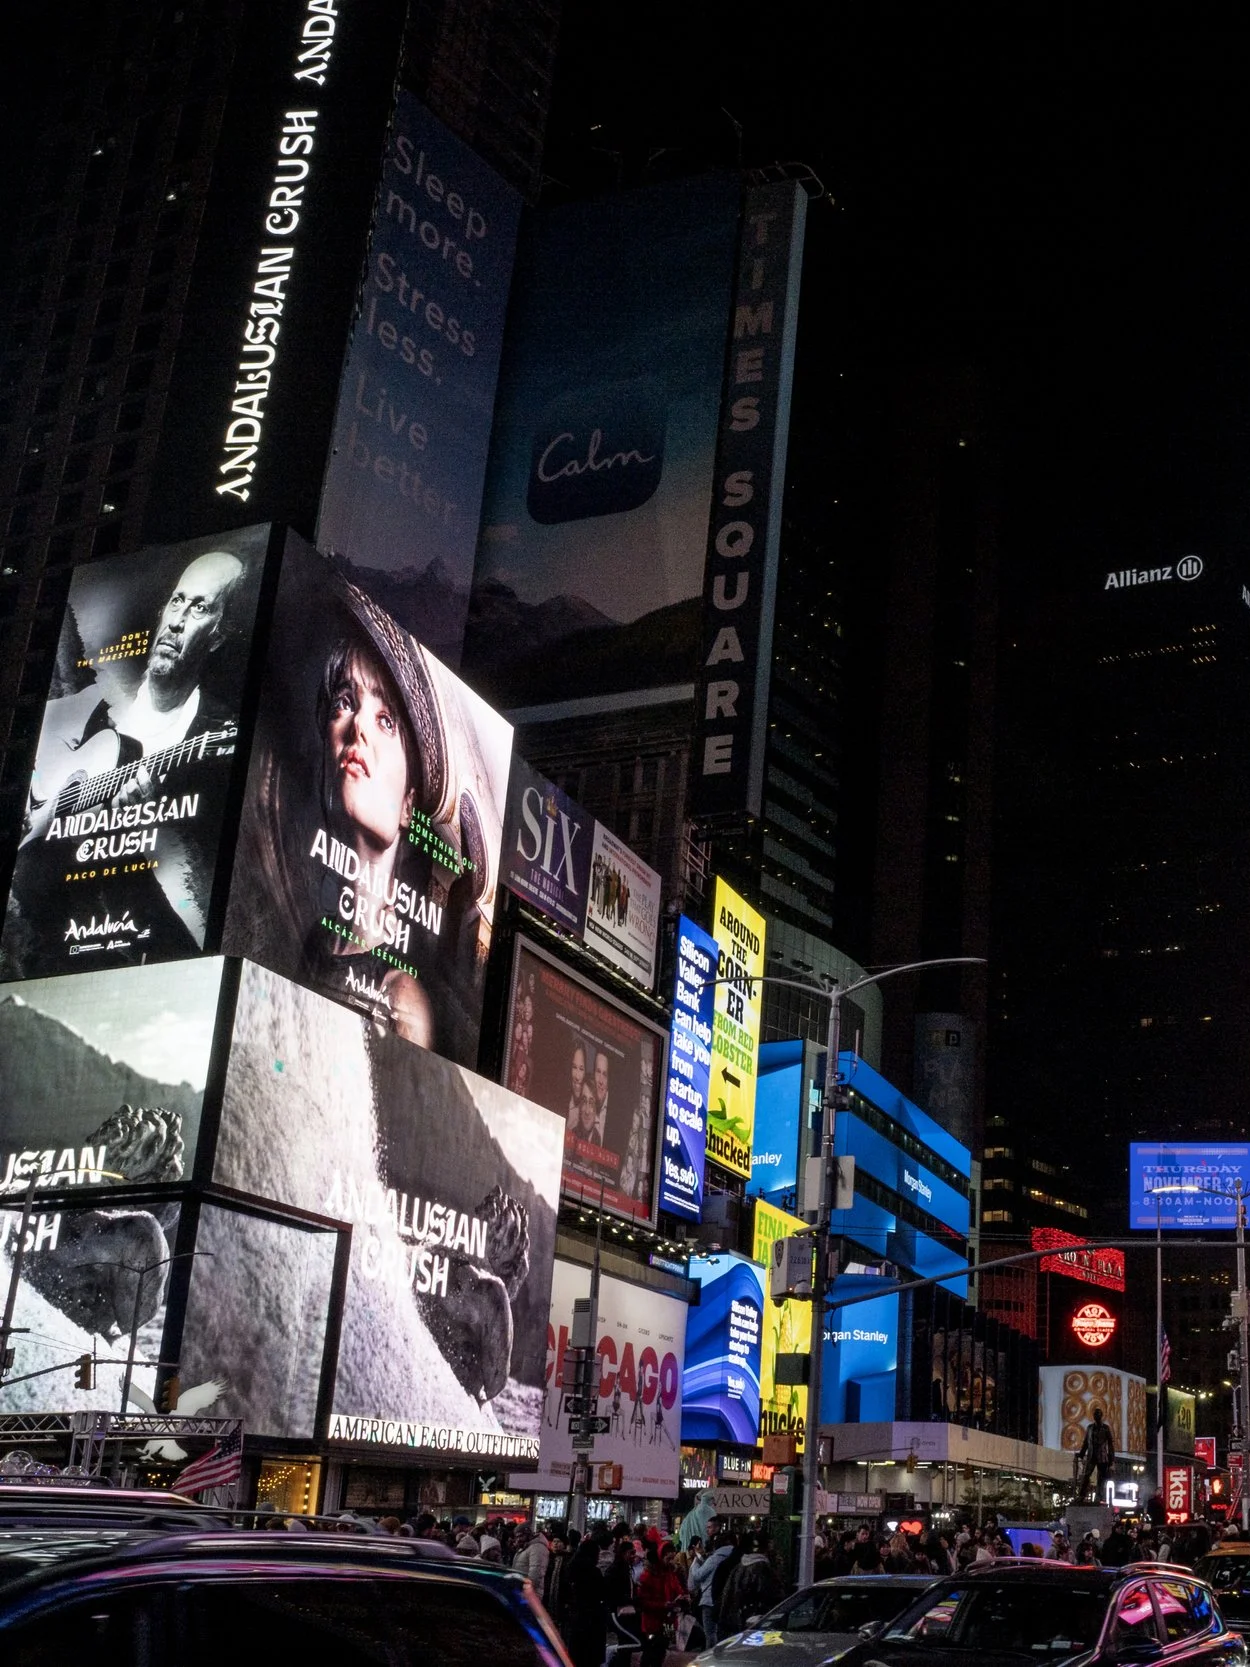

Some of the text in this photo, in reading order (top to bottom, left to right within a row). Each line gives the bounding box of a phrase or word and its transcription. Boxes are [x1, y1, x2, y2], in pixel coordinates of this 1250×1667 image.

[393, 135, 488, 241] Sleep
[386, 190, 482, 287] more.
[216, 110, 319, 501] ANDALUSIAN CRUSH
[375, 252, 476, 358] Stress
[367, 299, 443, 386] less.
[354, 370, 428, 452] Live
[536, 429, 657, 483] Calm
[702, 211, 776, 776] TIMES SQUARE
[1104, 566, 1172, 590] Allianz
[100, 639, 148, 655] LISTEN TO
[121, 630, 150, 642] DON'T
[77, 647, 147, 668] THE MAESTROS
[45, 794, 200, 841] ANDALUSIAN
[412, 807, 431, 827] LIKE
[76, 828, 158, 862] CRUSH
[408, 833, 420, 847] OF
[432, 851, 460, 875] DREAM
[410, 820, 459, 860] SOMETHING
[517, 787, 579, 895] SIX
[65, 870, 97, 881] PACO
[103, 866, 117, 875] DE
[309, 828, 443, 936] ANDALUSIAN
[339, 886, 410, 954] CRUSH
[719, 906, 760, 956] AROUND
[680, 935, 710, 973] Silicon
[732, 938, 748, 966] THE
[678, 956, 706, 995] Valley
[676, 980, 701, 1013] Bank
[727, 988, 745, 1025] ER
[674, 1008, 712, 1045] can help
[713, 1009, 754, 1053] FROM RED
[671, 1051, 694, 1080] from
[673, 1027, 711, 1067] take you
[669, 1077, 703, 1109] startup
[667, 1098, 703, 1133] to scale
[666, 1124, 681, 1147] up.
[752, 1152, 783, 1167] anley
[1143, 1164, 1243, 1174] THURSDAY
[1143, 1176, 1221, 1194] NOVEMBER
[324, 1170, 488, 1258] ANDALUSIAN
[361, 1229, 449, 1298] CRUSH
[1084, 1306, 1105, 1316] HOT
[823, 1329, 888, 1345] organ Stanley
[333, 1418, 540, 1459] AMERICAN EAGLE OUTFITTERS
[723, 1456, 739, 1470] BLUE
[1169, 1468, 1188, 1510] tkts
